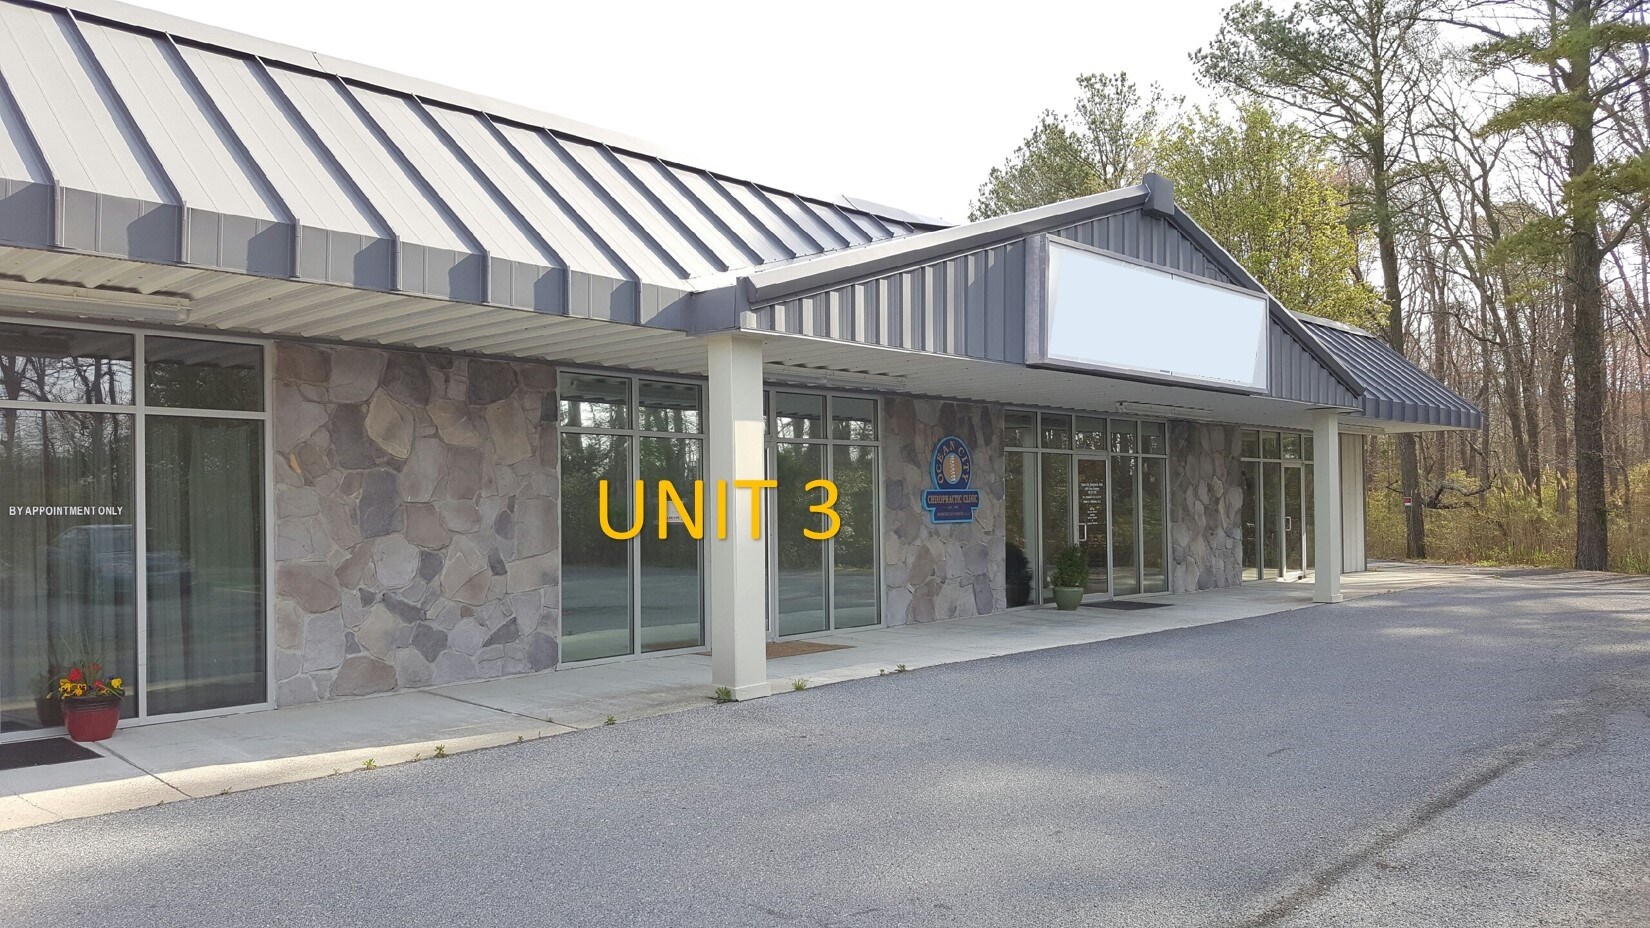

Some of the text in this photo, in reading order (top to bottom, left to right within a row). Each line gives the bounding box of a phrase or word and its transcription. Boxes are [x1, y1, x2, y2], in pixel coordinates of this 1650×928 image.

[936, 440, 970, 484] OCEAN CITY
[927, 494, 978, 504] CHIROPRACTIC CLINIC
[8, 506, 123, 516] BY APPOINTMENT ONLY
